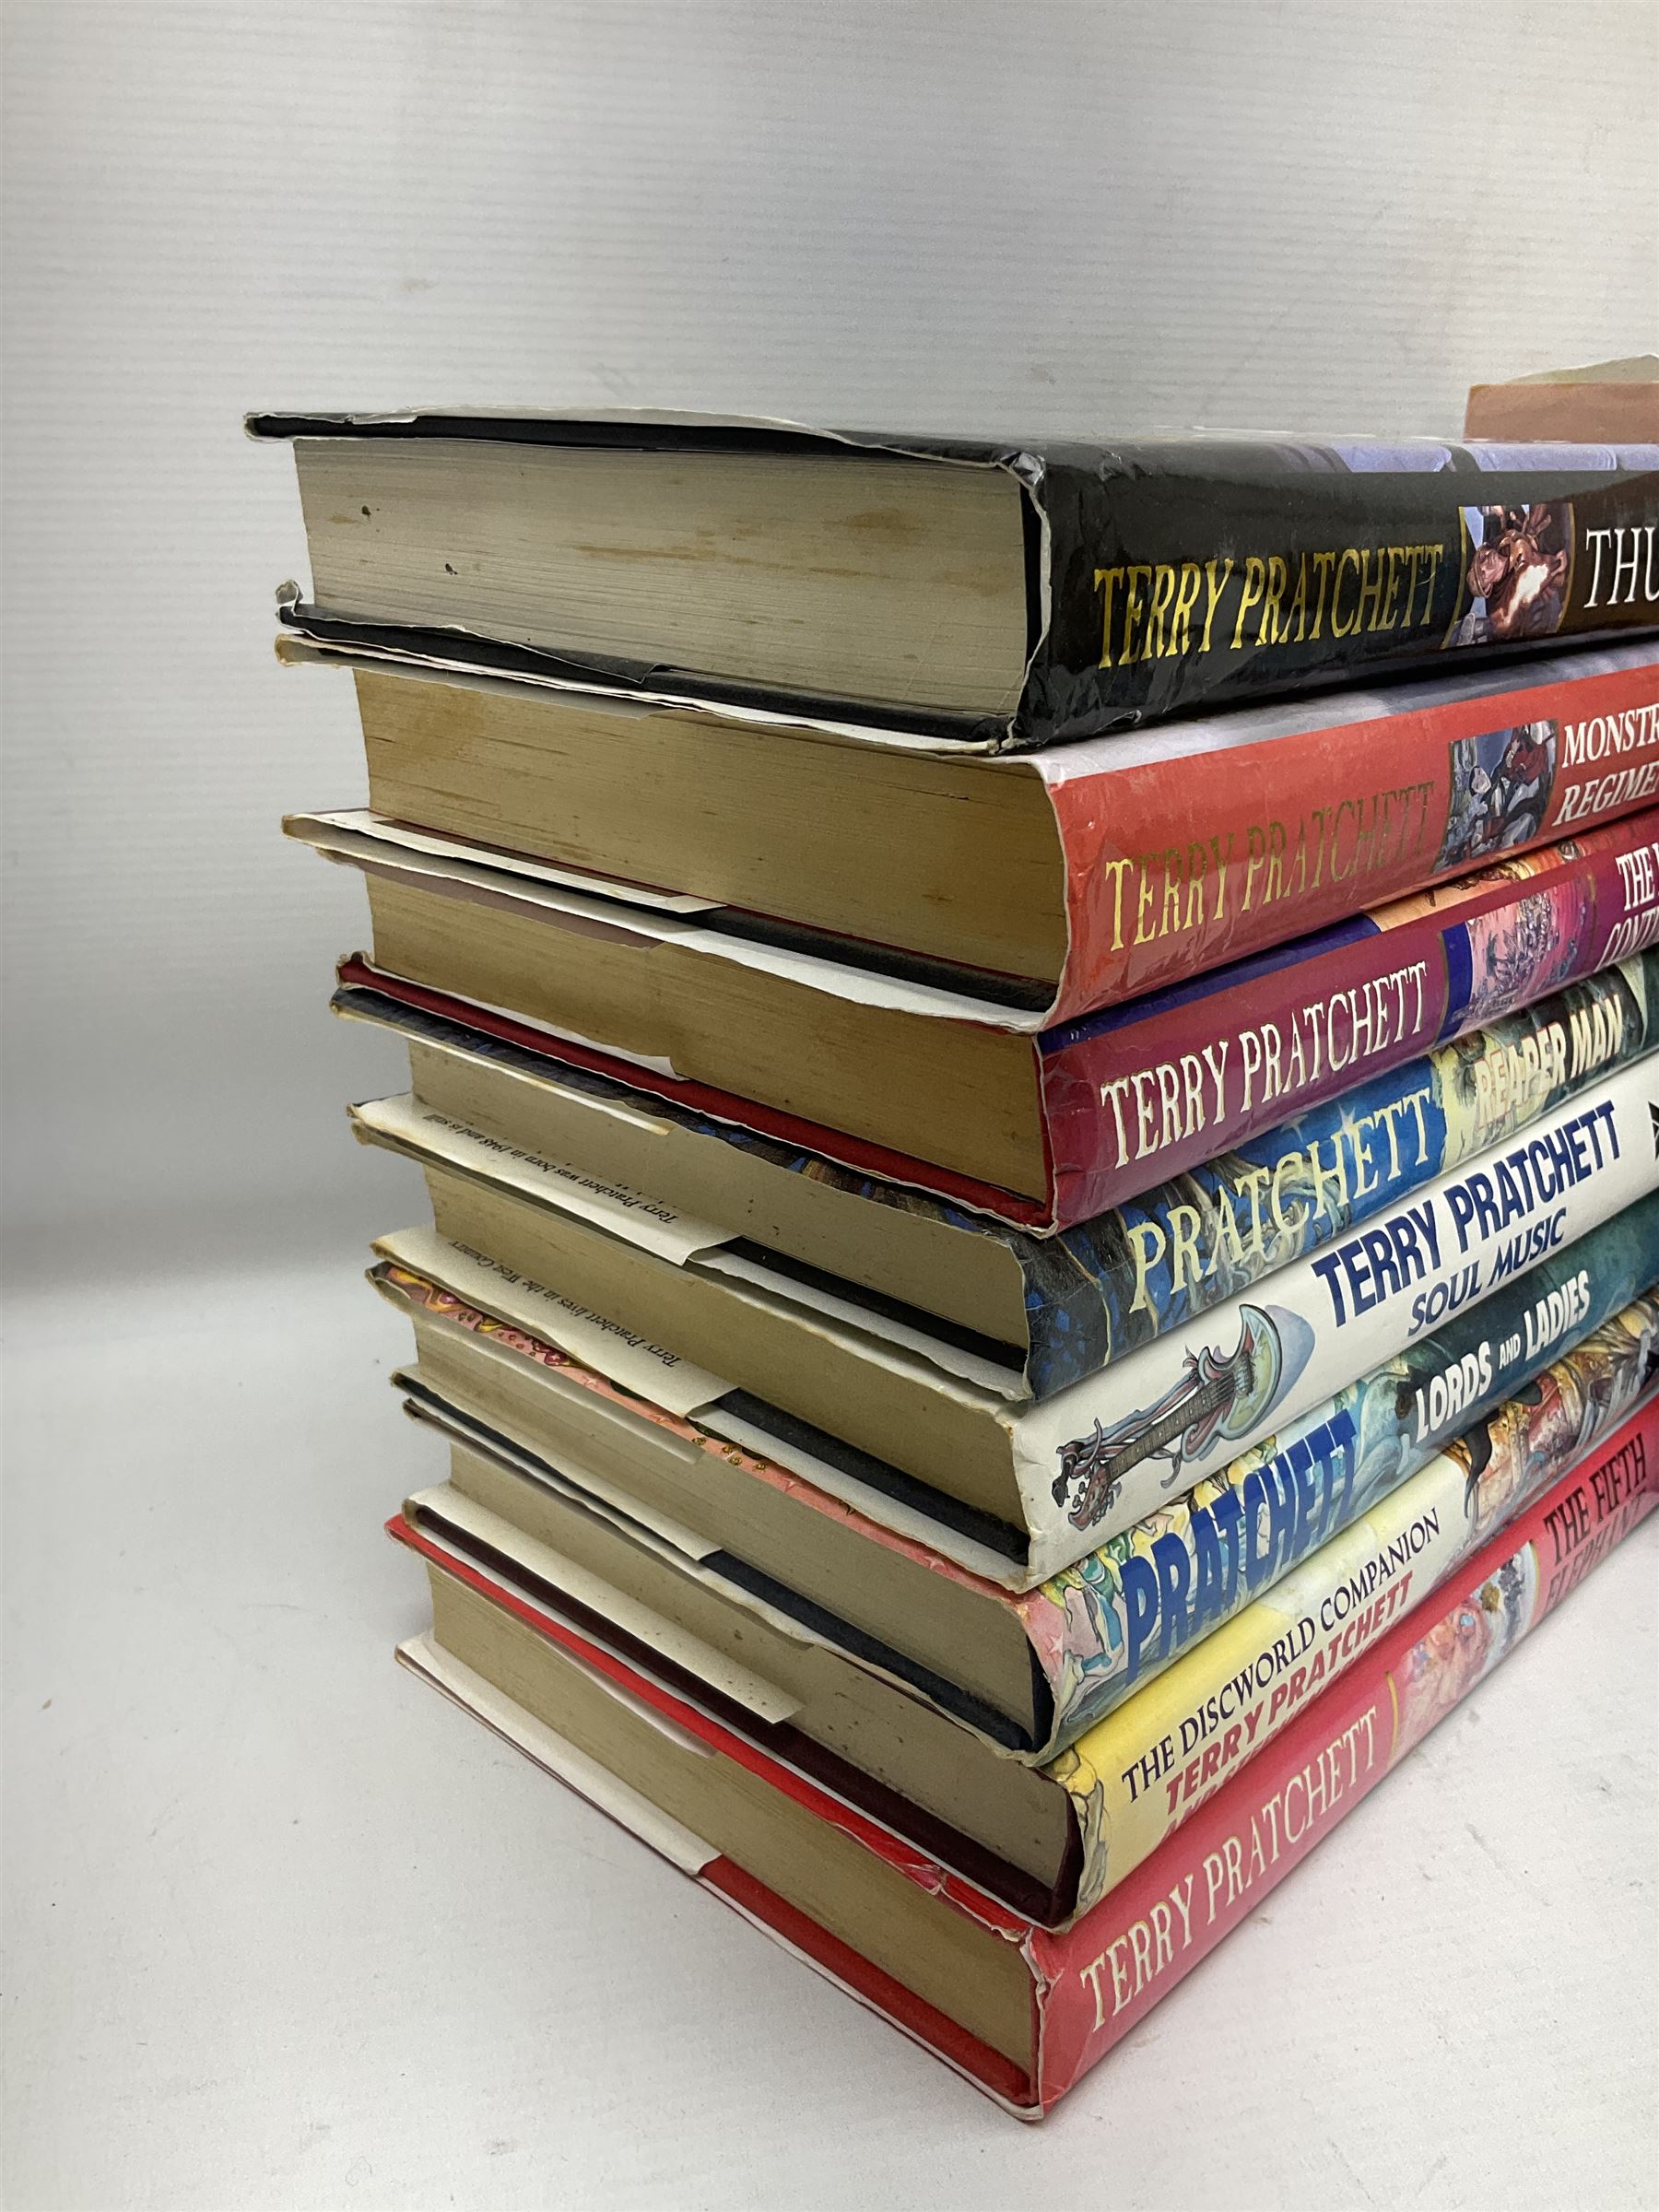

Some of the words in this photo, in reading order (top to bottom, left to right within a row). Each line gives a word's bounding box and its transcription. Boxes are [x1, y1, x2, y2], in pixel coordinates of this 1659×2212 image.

[1093, 557, 1233, 668] TERRY
[1230, 544, 1443, 649] PRATCHETT
[1105, 837, 1235, 952] TERRY
[1241, 782, 1434, 912] PRATCHETT
[1616, 846, 1655, 912] THE
[1100, 1041, 1230, 1170] TERRY
[1240, 962, 1427, 1107] PRATCHETT
[1475, 1021, 1567, 1131] REAPER
[1570, 994, 1623, 1079] MAN
[511, 1149, 528, 1159] in
[524, 1156, 556, 1172] born
[554, 1169, 579, 1182] was
[579, 1179, 640, 1207] Pratchett
[640, 1203, 678, 1224] Terry
[1129, 1087, 1431, 1313] PRATCHETT
[1311, 1201, 1440, 1327] TERRY
[1443, 1100, 1620, 1241] PRATCHETT
[493, 1265, 522, 1283] West
[523, 1280, 546, 1292] the
[544, 1290, 560, 1301] in
[558, 1298, 588, 1317] lives
[585, 1313, 645, 1347] Pratchett
[1408, 1265, 1480, 1336] SOUL
[1488, 1208, 1567, 1291] MUSIC
[643, 1342, 681, 1368] Terry
[1416, 1342, 1491, 1445] LORDS
[1499, 1333, 1521, 1371] AND
[1522, 1270, 1590, 1358] LADIES
[1123, 1409, 1357, 1684] PRATCHETT
[1543, 1486, 1592, 1565] THE
[1589, 1432, 1646, 1521] FIFTH
[1122, 1735, 1175, 1803] THE
[1180, 1618, 1315, 1757] DISCWORLD
[1320, 1508, 1440, 1631] COMPANION
[1165, 1701, 1264, 1816] TERRY
[1267, 1571, 1415, 1725] PRATCHETT
[1081, 1874, 1194, 2032] TERRY
[1203, 1705, 1377, 1926] PRATCHETT
